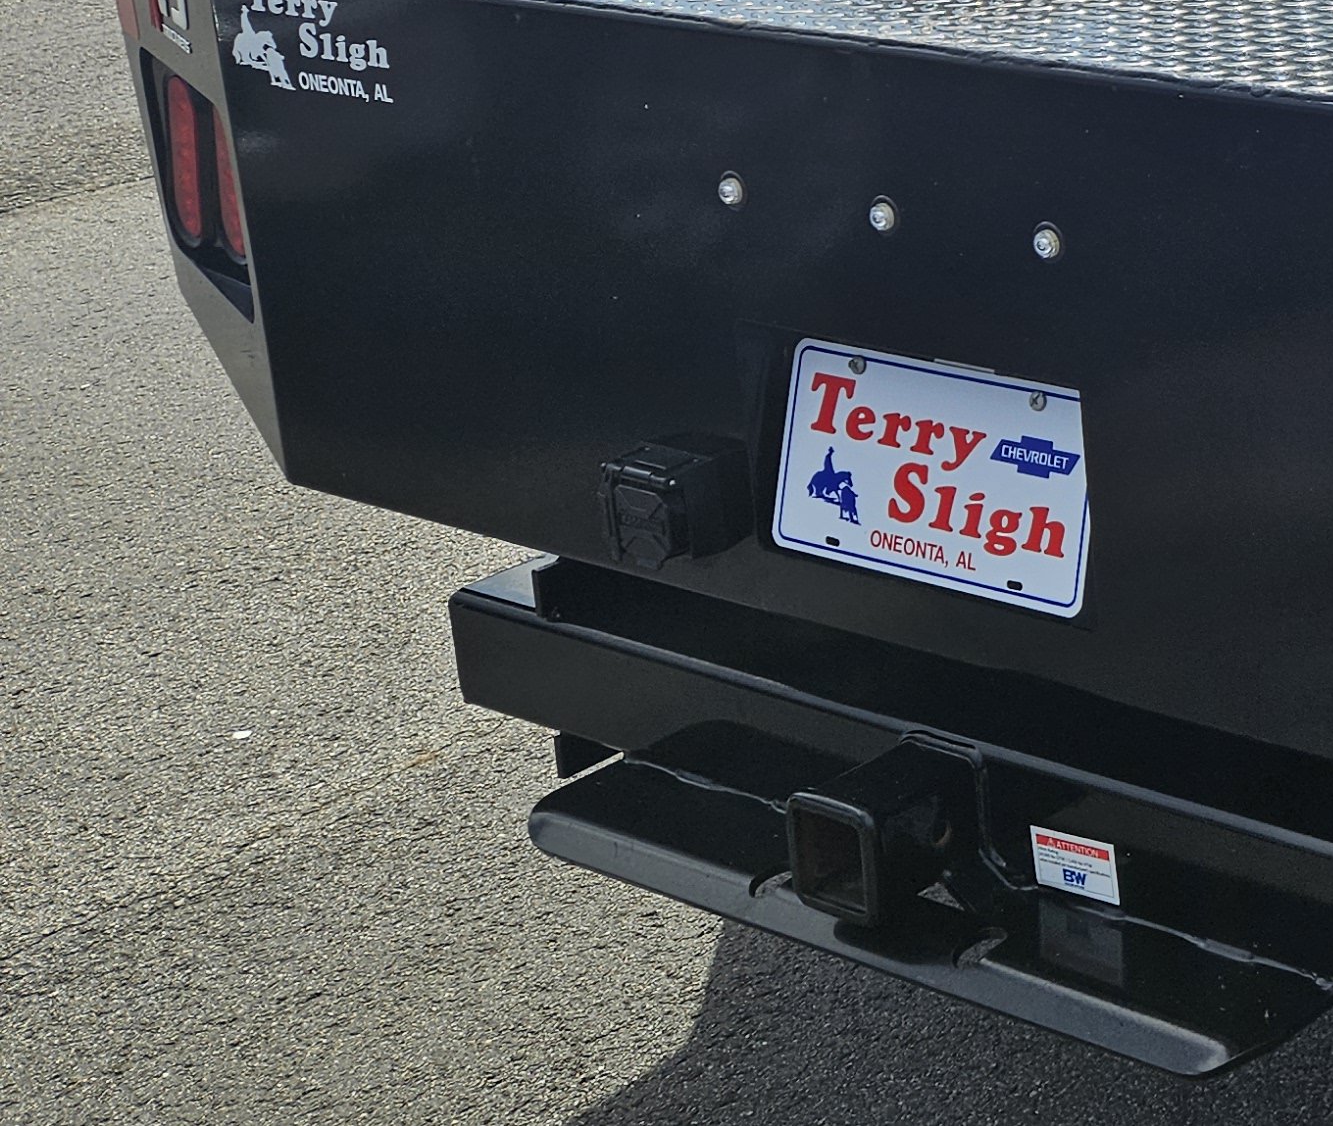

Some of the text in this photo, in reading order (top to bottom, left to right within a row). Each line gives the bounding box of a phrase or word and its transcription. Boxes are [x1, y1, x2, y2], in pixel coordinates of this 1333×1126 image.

[299, 23, 390, 71] Sligh
[299, 72, 393, 103] ONEONTA, AL
[810, 372, 987, 471] Terry
[1000, 444, 1070, 470] CHEVROLET
[887, 462, 1066, 559] Sligh
[870, 530, 977, 571] ONEONTA, AL
[1056, 842, 1098, 858] ATTENTION
